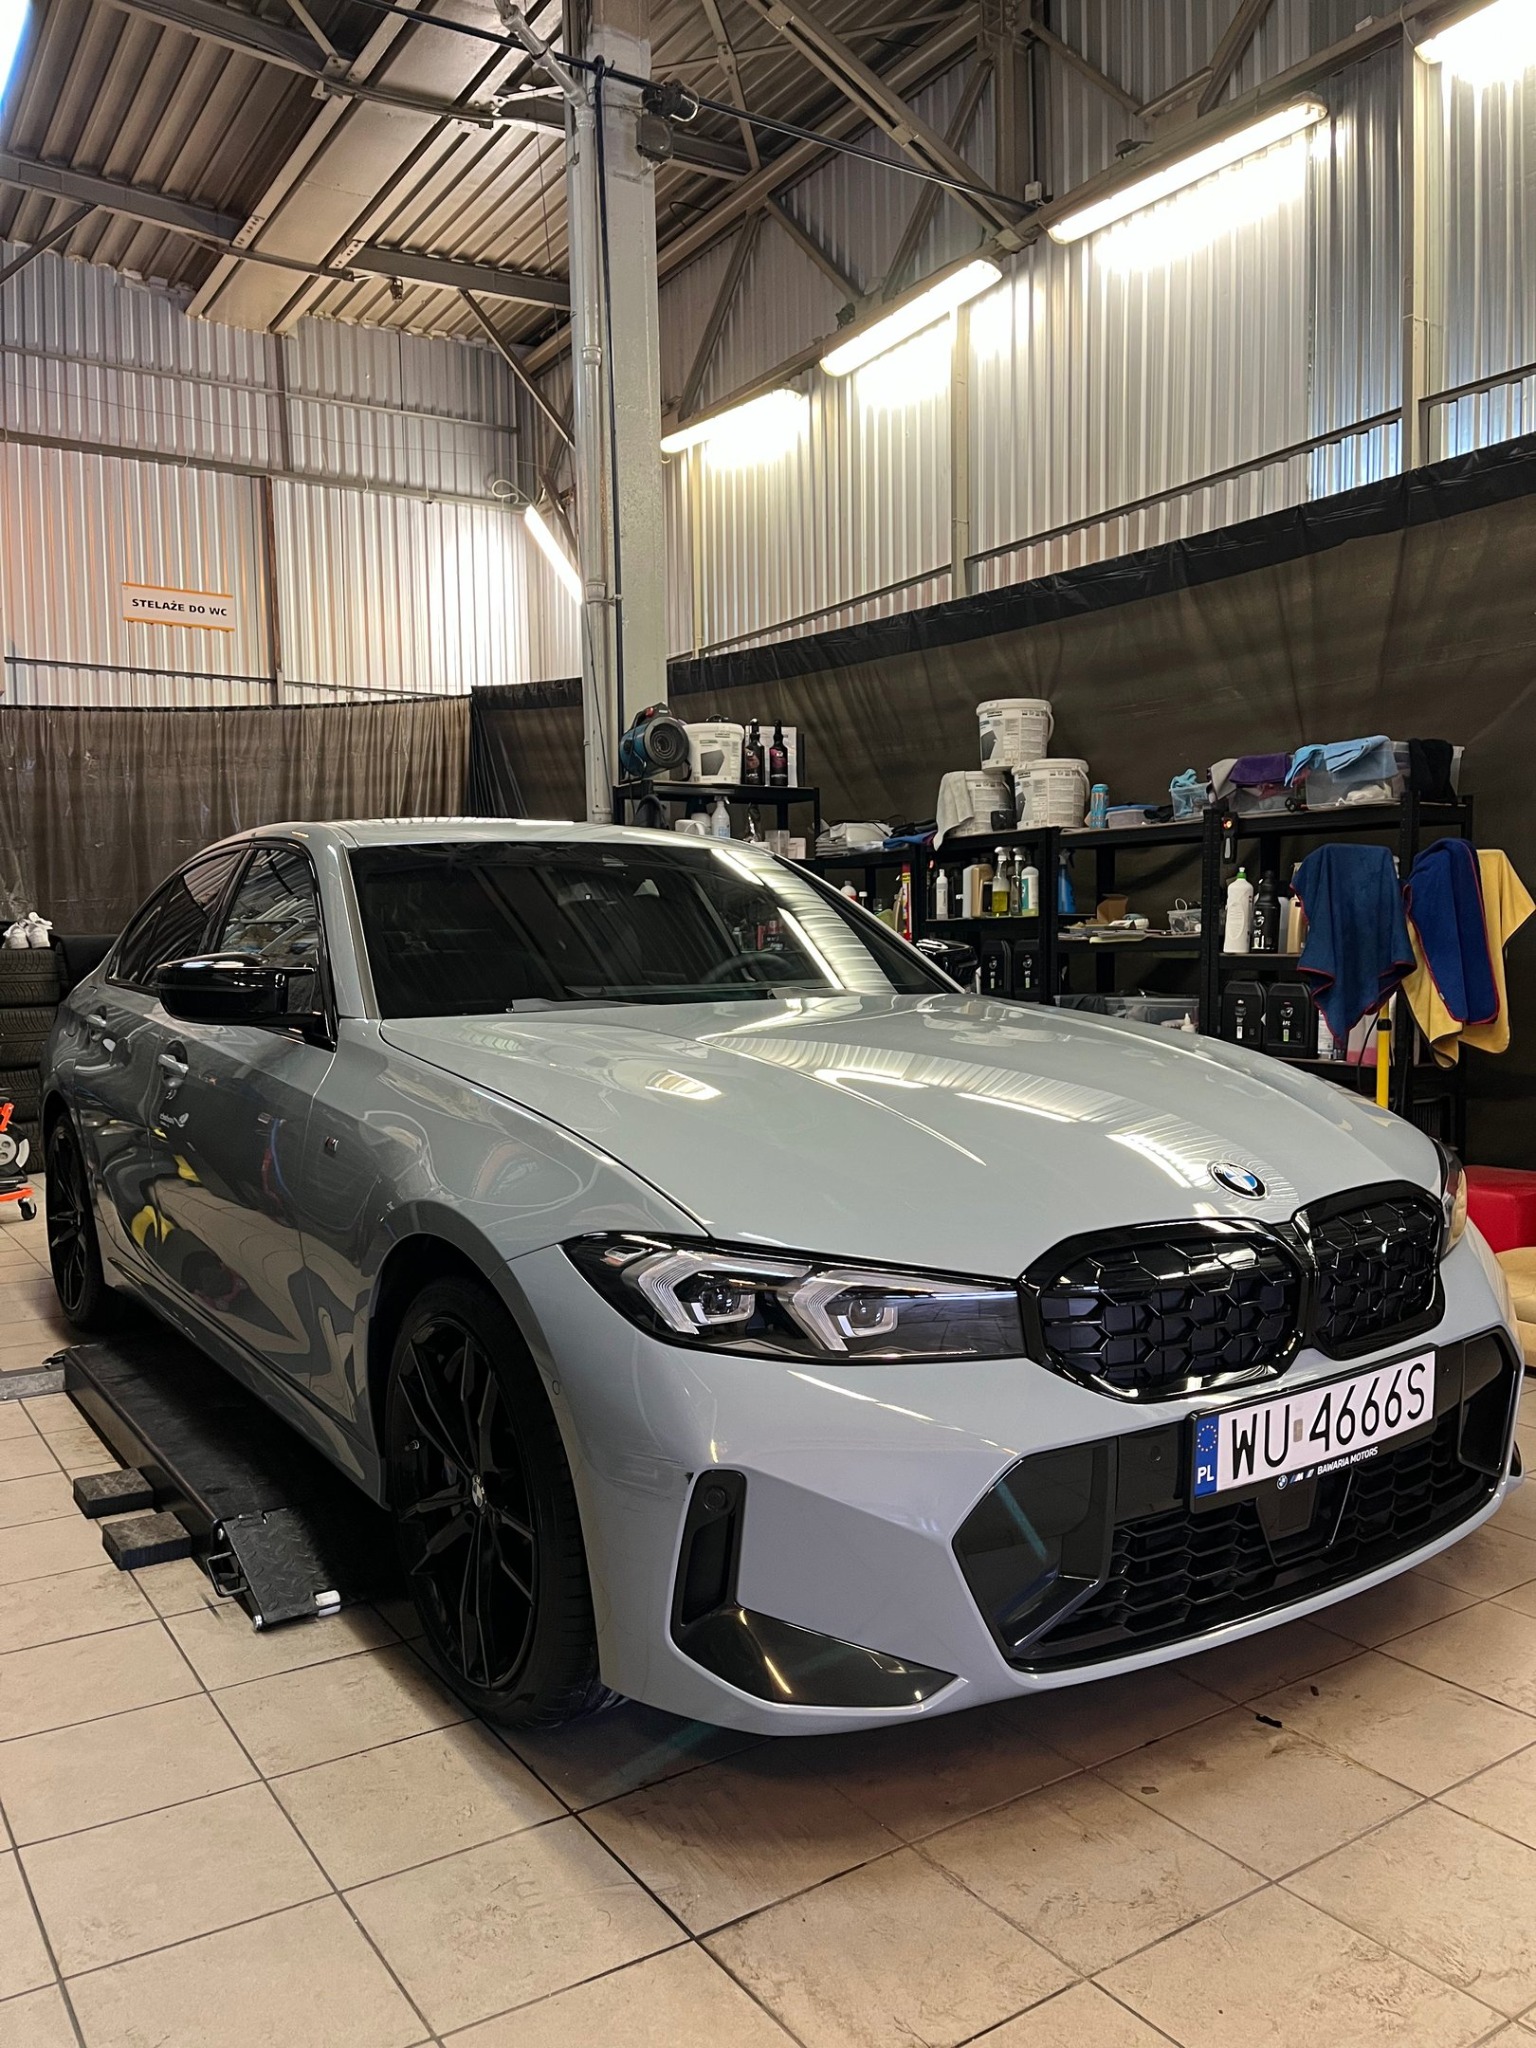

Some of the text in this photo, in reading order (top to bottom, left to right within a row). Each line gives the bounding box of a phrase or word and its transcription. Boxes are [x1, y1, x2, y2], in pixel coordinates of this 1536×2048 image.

[132, 599, 228, 616] STELAŻE DO WC
[1232, 1363, 1425, 1480] WU 4666S
[1317, 1458, 1349, 1475] BAWARIA
[1349, 1446, 1378, 1464] MOTORS
[1197, 1465, 1214, 1484] PL
